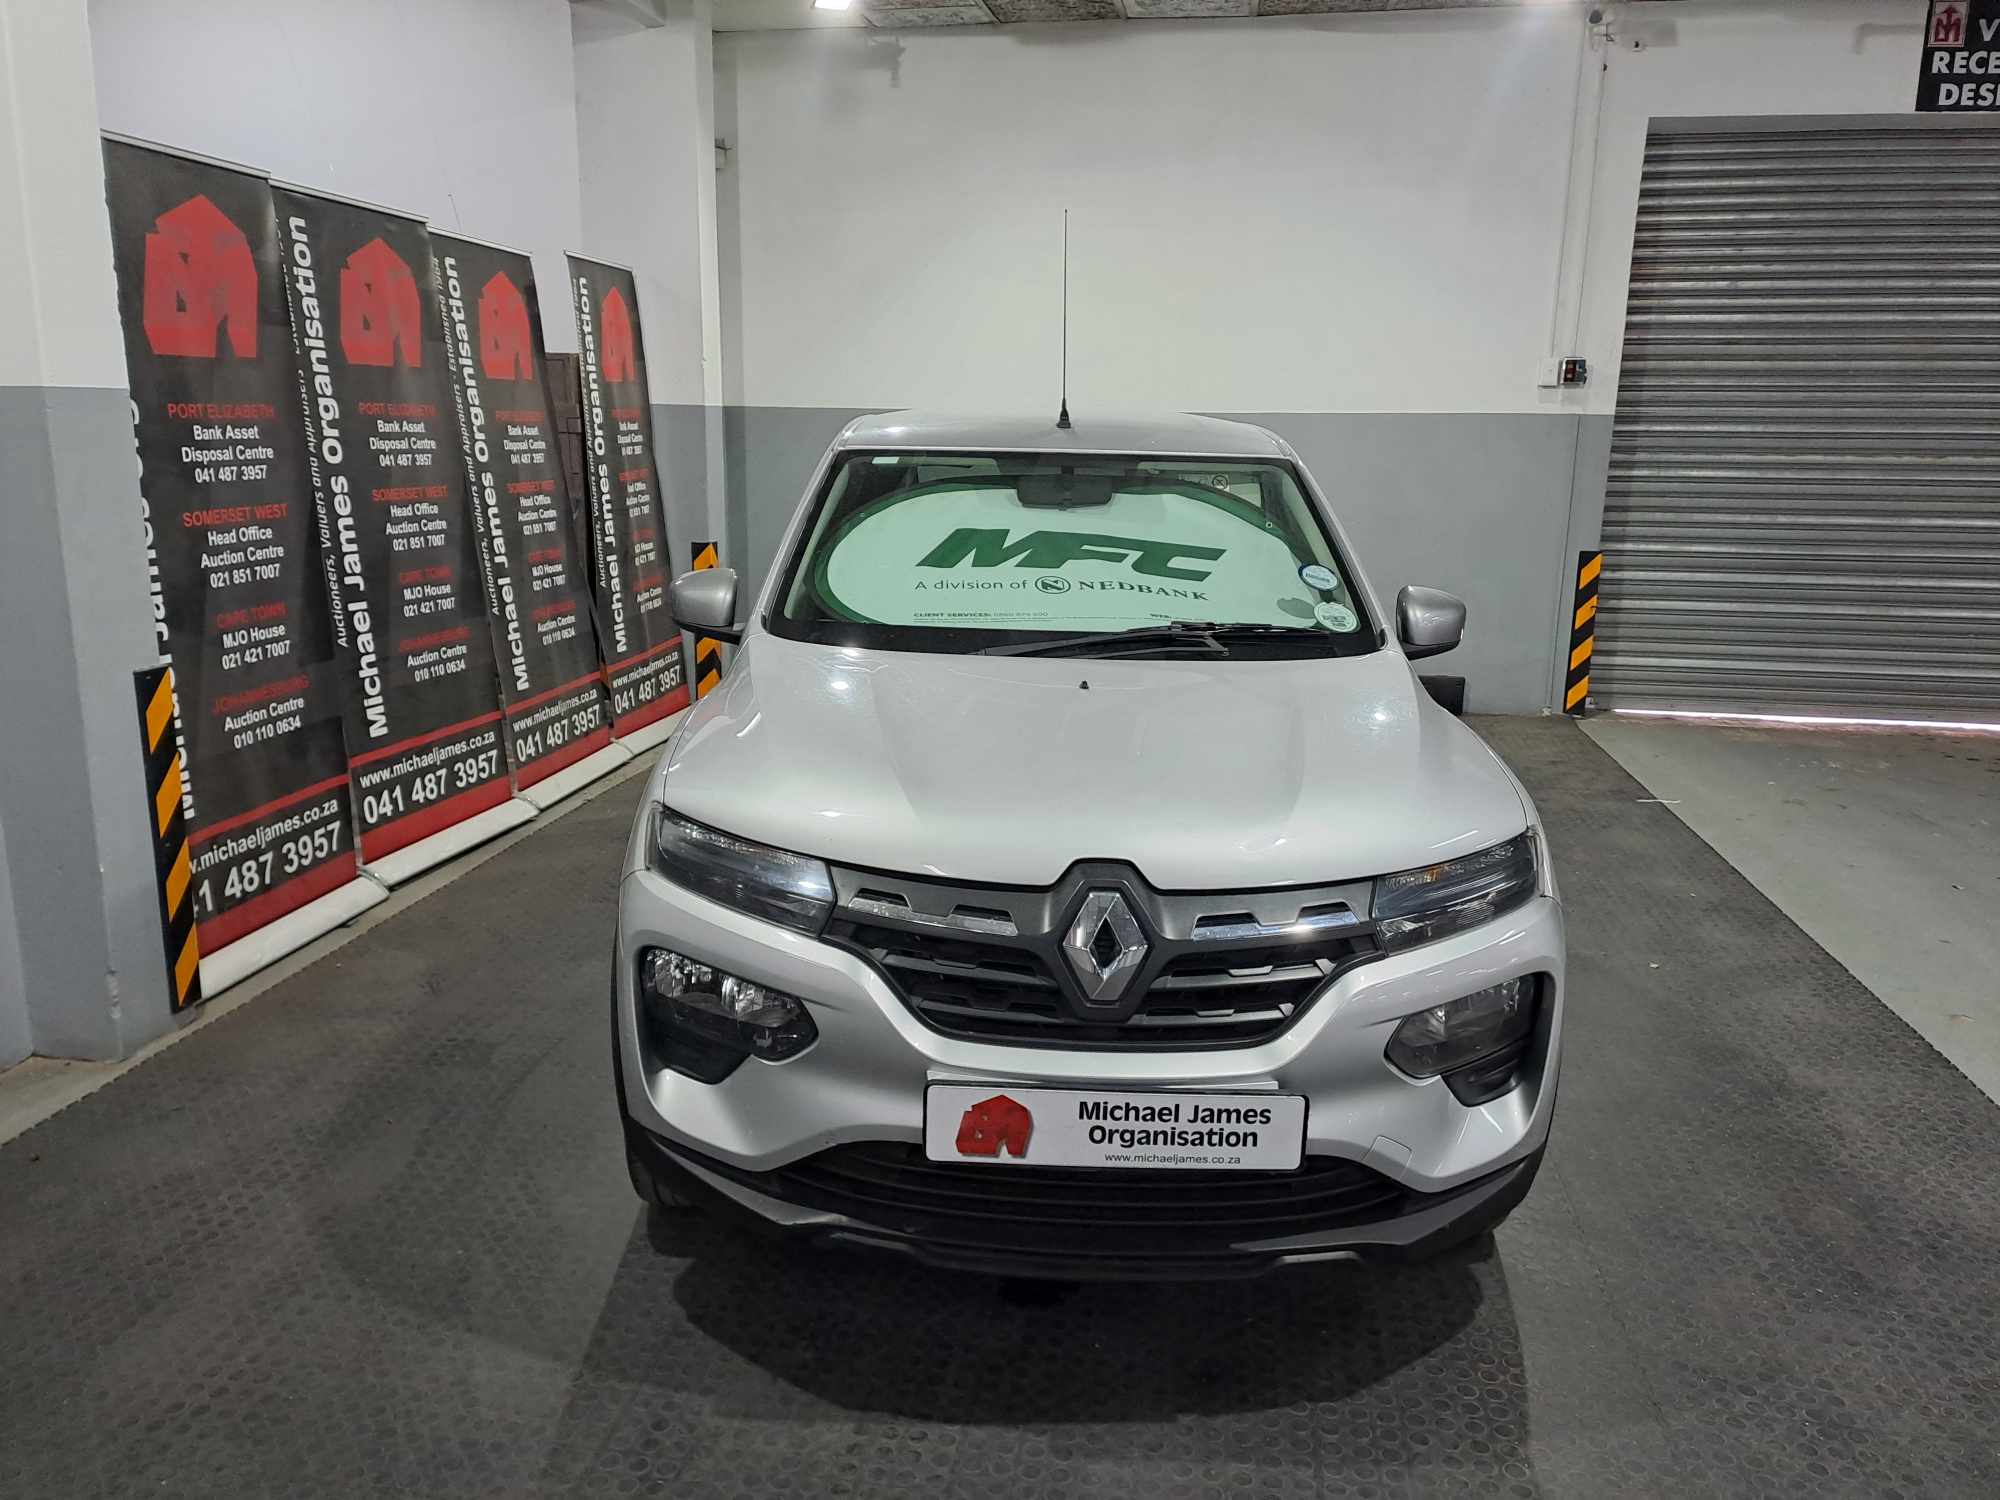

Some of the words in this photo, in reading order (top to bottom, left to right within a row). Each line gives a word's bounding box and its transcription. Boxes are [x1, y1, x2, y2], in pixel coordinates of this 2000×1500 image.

[1932, 51, 2000, 74] RECE
[1938, 83, 2000, 106] DES
[289, 216, 343, 464] Organisation
[444, 256, 488, 462] Organisation
[580, 277, 605, 456] Organisation
[167, 403, 203, 419] PORT
[359, 402, 384, 416] PORT
[454, 383, 471, 453] Appraisers
[193, 425, 223, 440] Bank
[225, 425, 259, 439] Asset
[377, 420, 400, 433] Bank
[402, 420, 425, 433] Asset
[181, 446, 233, 464] Disposal
[236, 445, 274, 460] Centre
[369, 437, 408, 451] Disposal
[410, 437, 436, 449] Centre
[379, 454, 395, 466] 041
[397, 454, 412, 466] 487
[415, 454, 432, 465] 3957
[465, 456, 476, 481] and
[195, 468, 216, 483] 041
[218, 466, 237, 482] 487
[241, 465, 267, 480] 3957
[183, 507, 250, 527] SOMERSET
[255, 503, 288, 520] WEST
[390, 504, 412, 517] Head
[414, 503, 439, 515] Office
[472, 486, 485, 532] Valuers
[599, 464, 615, 546] James
[314, 490, 332, 548] Valuers
[386, 521, 419, 535] Auction
[421, 519, 447, 531] Centre
[482, 472, 508, 568] James
[208, 529, 237, 546] Head
[239, 526, 273, 542] Office
[330, 475, 365, 591] James
[393, 538, 408, 551] 021
[410, 537, 425, 550] 851
[427, 534, 445, 547] 7007
[201, 549, 244, 568] Auction
[247, 544, 284, 560] Centre
[915, 527, 1227, 582] MFC
[210, 572, 230, 588] 021
[233, 568, 251, 584] 851
[254, 563, 281, 580] 7007
[481, 538, 500, 615] Auctioneers,
[325, 554, 349, 648] Auctioneers,
[404, 587, 422, 600] MJO
[424, 584, 451, 598] House
[915, 580, 927, 590] A
[934, 578, 1003, 590] division
[1011, 578, 1030, 590] of
[1079, 580, 1209, 601] NEDBANK
[404, 605, 419, 617] 021
[420, 602, 435, 615] 421
[437, 597, 455, 610] 7007
[606, 554, 627, 652] Michael
[223, 631, 248, 649] MJO
[250, 624, 285, 642] House
[498, 577, 529, 691] Michael
[222, 652, 241, 670] 021
[244, 646, 264, 664] 421
[266, 640, 291, 658] 7007
[407, 651, 439, 667] Auction
[440, 645, 467, 659] Centre
[347, 601, 389, 739] Michael
[614, 688, 635, 714] 041
[639, 678, 656, 702] 487
[659, 665, 680, 692] 3957
[224, 705, 267, 731] Auction
[269, 697, 304, 717] Centre
[234, 731, 253, 749] 010
[255, 723, 274, 741] 110
[276, 715, 301, 735] 0634
[517, 730, 542, 762] 041
[547, 719, 568, 747] 487
[572, 704, 599, 735] 3957
[360, 731, 495, 788] www.michaeljames.co.za
[363, 784, 404, 824] 041
[412, 768, 447, 803] 487
[454, 750, 497, 788] 3957
[224, 852, 274, 899] 487
[282, 820, 341, 874] 3957
[1078, 1100, 1180, 1123] Michael
[1188, 1102, 1272, 1125] James
[1088, 1124, 1259, 1149] Organisation
[1105, 1152, 1241, 1165] www.michaeljames.co.za
